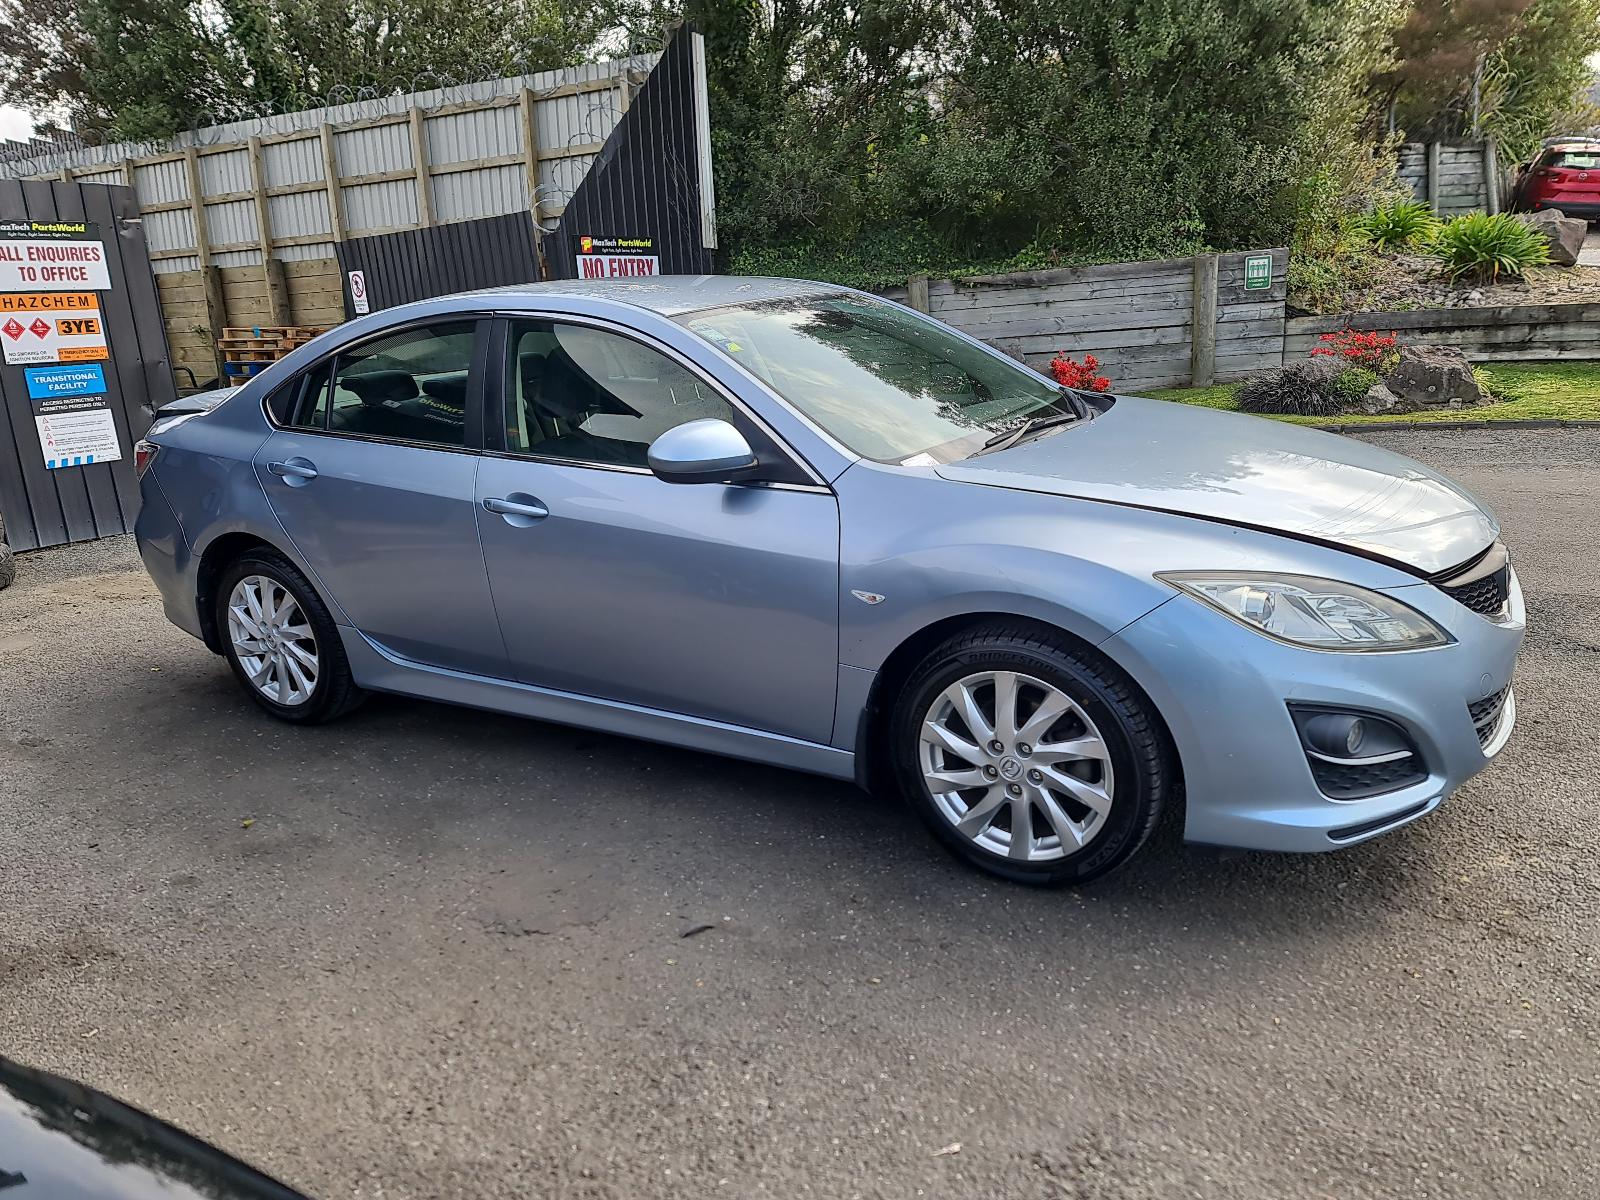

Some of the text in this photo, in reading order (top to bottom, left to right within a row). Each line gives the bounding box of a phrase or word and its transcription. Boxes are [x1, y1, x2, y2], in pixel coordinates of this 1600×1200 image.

[0, 223, 86, 232] axTech PartsWorld
[618, 239, 652, 247] PartsWorld
[0, 246, 100, 262] ALL ENQUIRIES
[18, 266, 89, 281] TO OFFICE
[582, 257, 654, 278] NO ENTRY
[3, 296, 90, 309] HAZCHEM
[61, 320, 96, 333] 3YE
[33, 373, 98, 384] TRANSITIONAL
[48, 381, 87, 390] FACILITY
[68, 402, 92, 410] PERSONS
